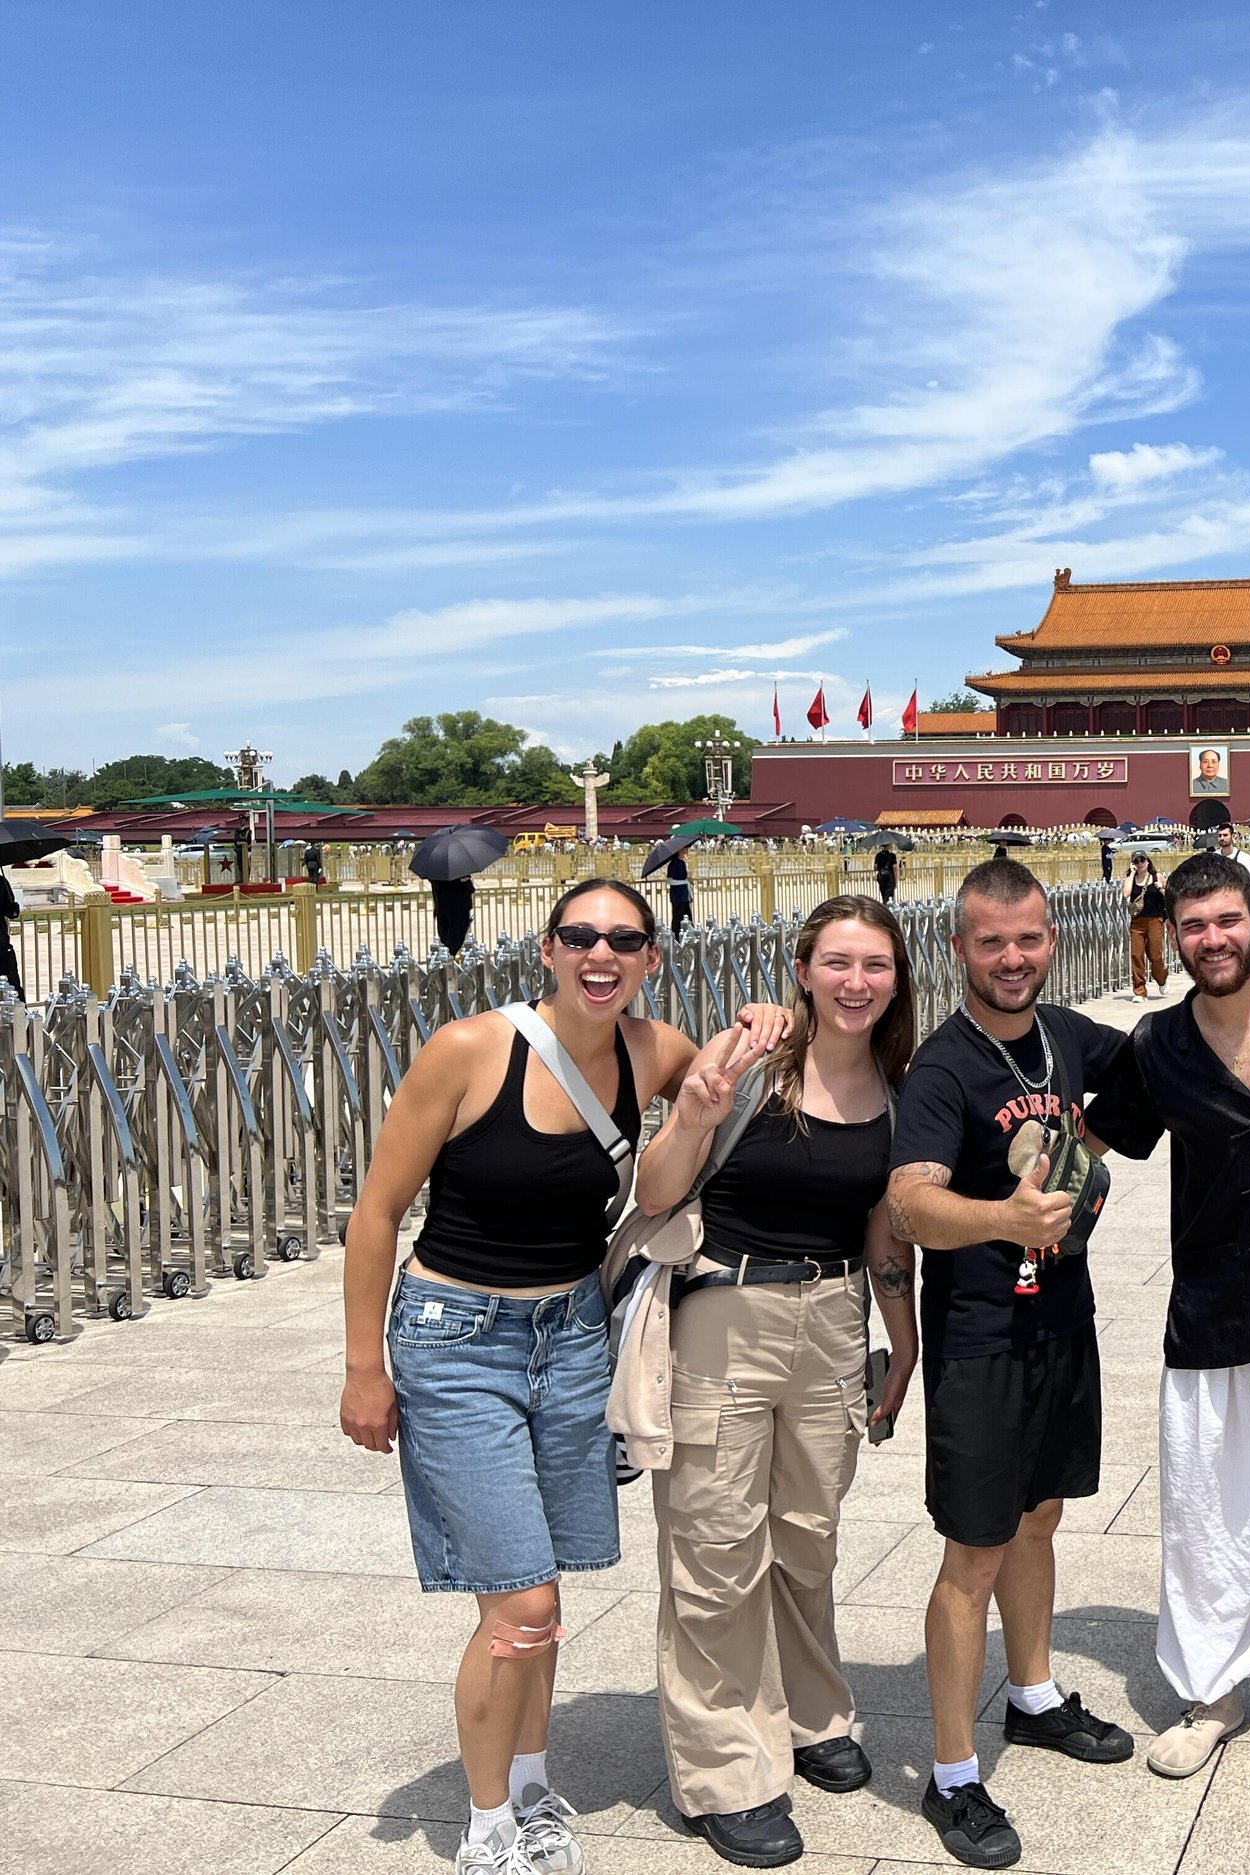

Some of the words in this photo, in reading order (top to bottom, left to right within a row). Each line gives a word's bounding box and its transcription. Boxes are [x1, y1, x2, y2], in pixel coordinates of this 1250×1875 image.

[905, 762, 1115, 781] 中华人民共和国万岁
